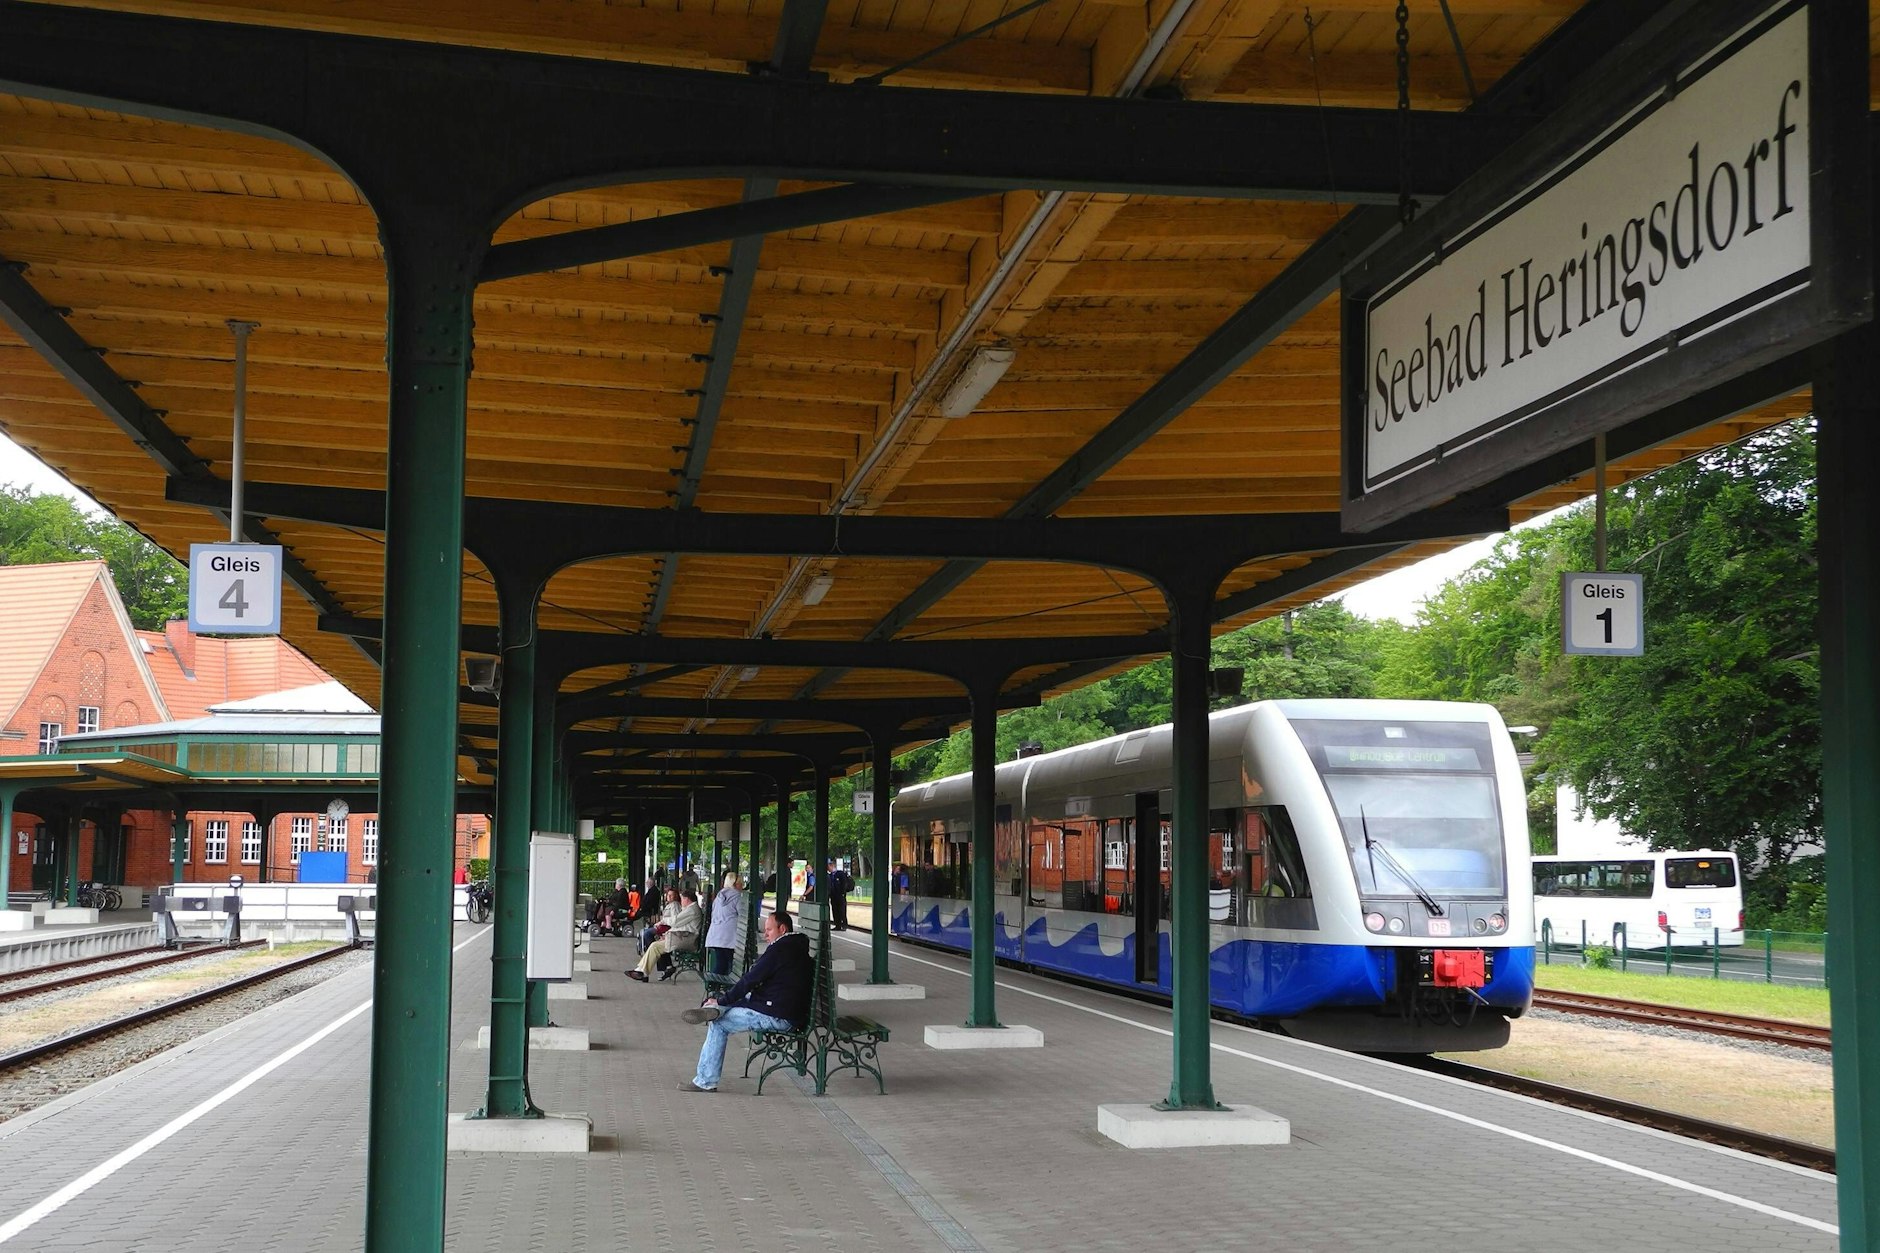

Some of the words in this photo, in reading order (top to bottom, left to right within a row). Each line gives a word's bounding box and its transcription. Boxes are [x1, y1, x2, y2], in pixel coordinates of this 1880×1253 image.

[1374, 279, 1488, 432] Seebad
[1501, 80, 1801, 368] Heringsdorf
[211, 556, 260, 572] Gleis
[218, 579, 249, 618] 4
[1583, 584, 1625, 599] Gleis
[1596, 608, 1612, 644] 1
[862, 800, 867, 810] 1
[1431, 922, 1448, 933] DB
